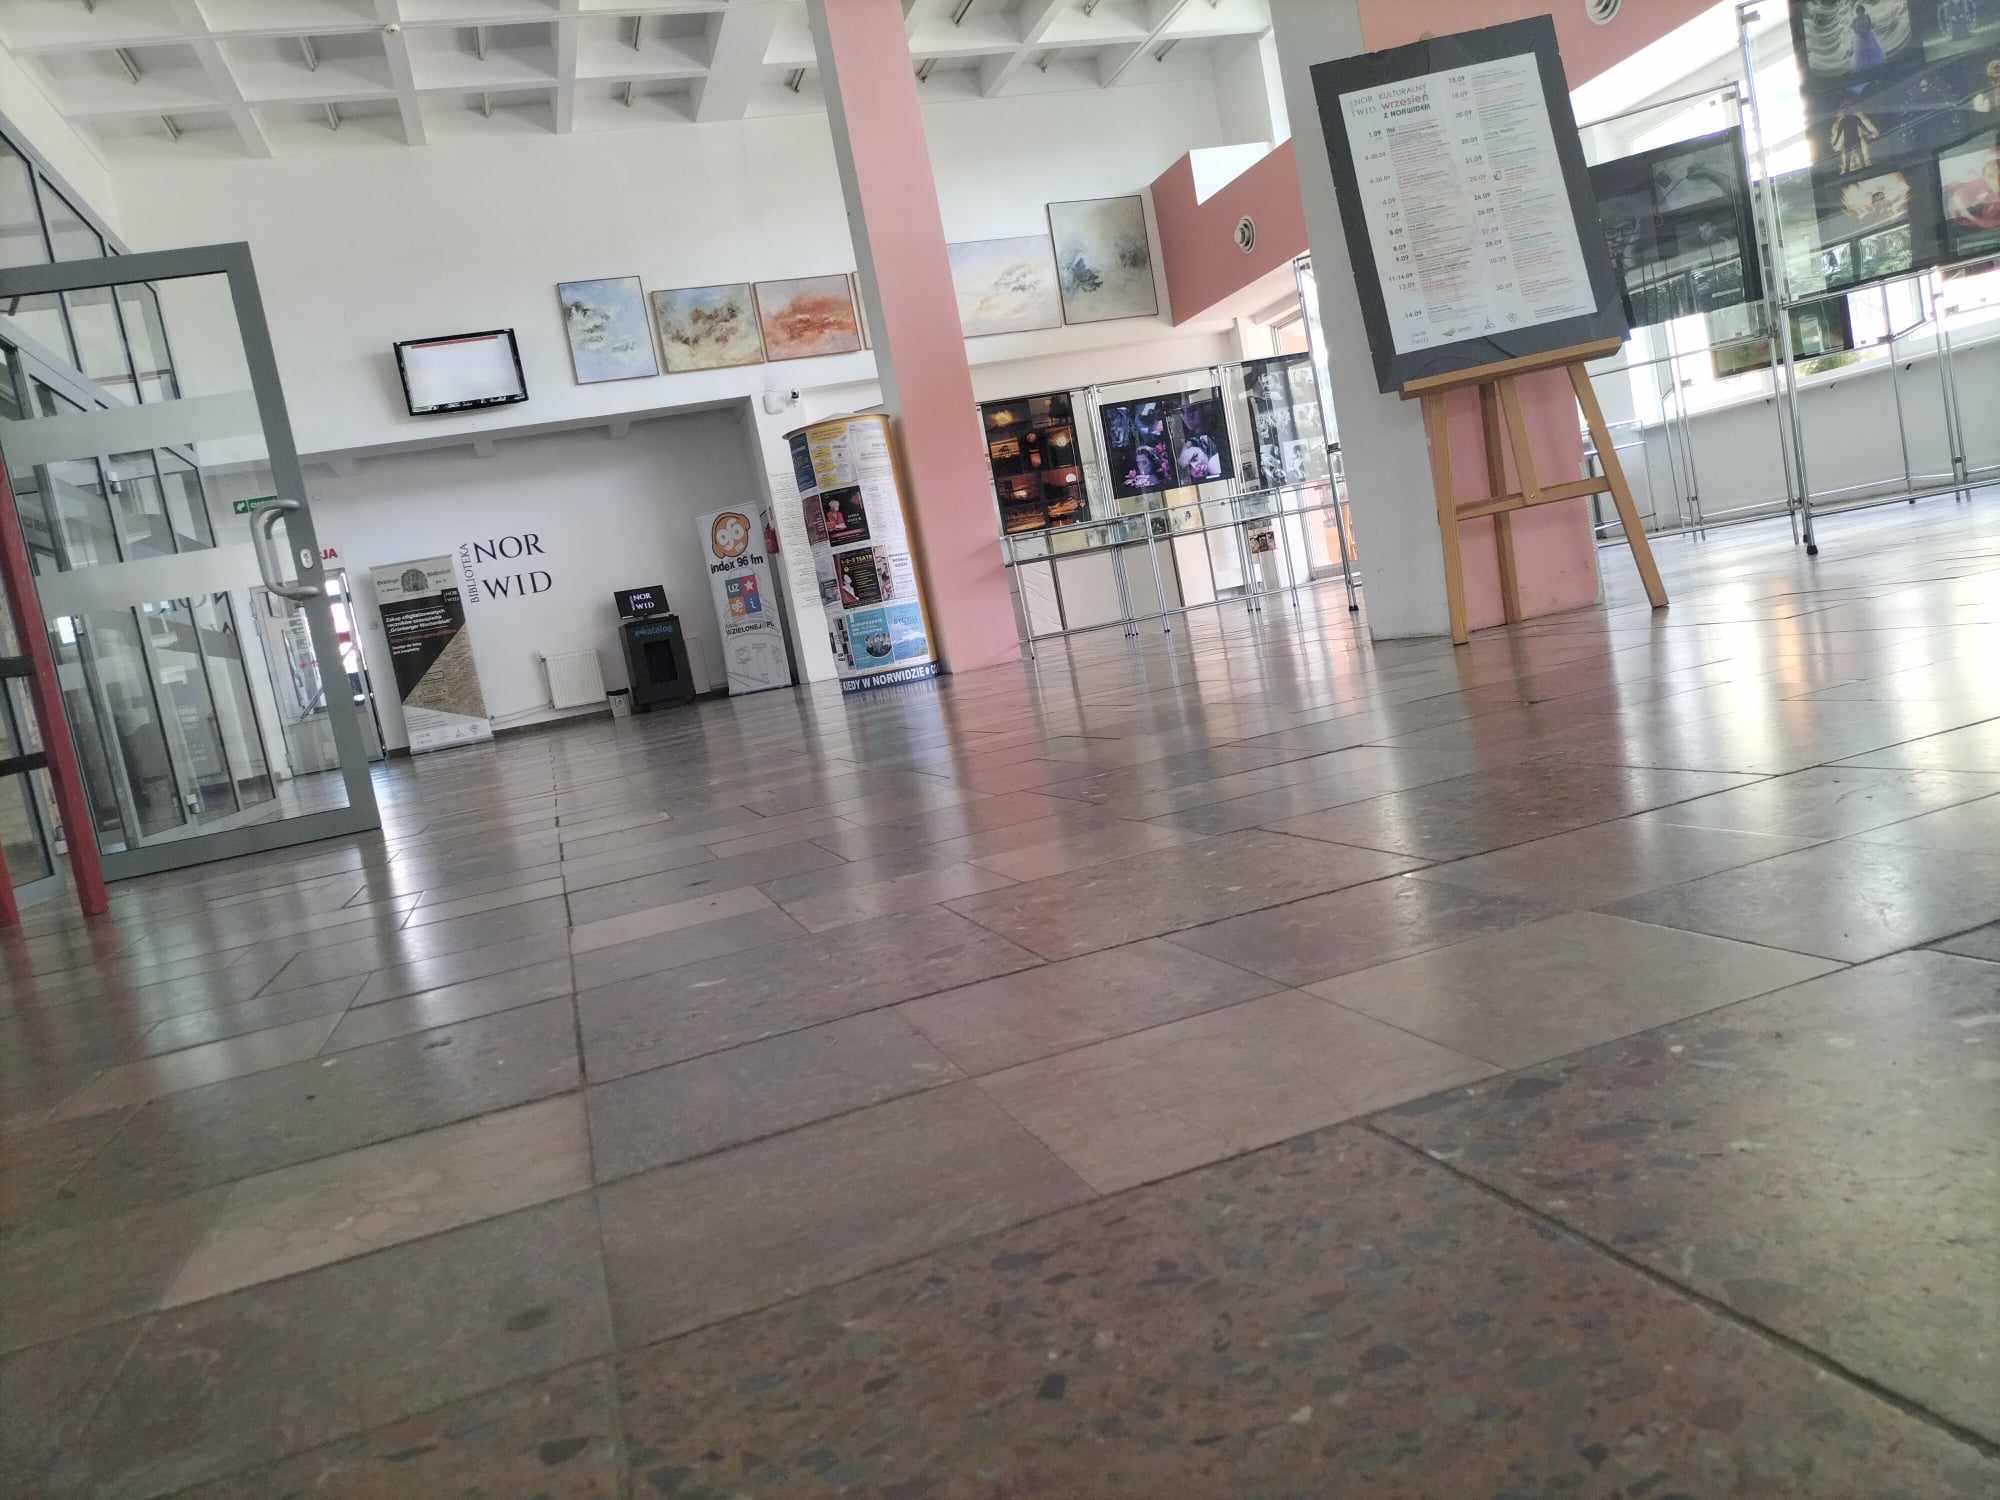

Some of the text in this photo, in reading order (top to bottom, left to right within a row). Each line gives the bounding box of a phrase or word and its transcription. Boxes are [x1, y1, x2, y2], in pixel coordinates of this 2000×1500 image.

[473, 533, 547, 563] NOR
[459, 543, 480, 603] BIBLIOTEKA
[710, 554, 764, 574] index 96 fm
[481, 570, 553, 600] WID
[632, 592, 652, 601] NOR
[635, 601, 655, 609] WID
[861, 678, 872, 689] W
[872, 666, 925, 686] NORWIDZIE
